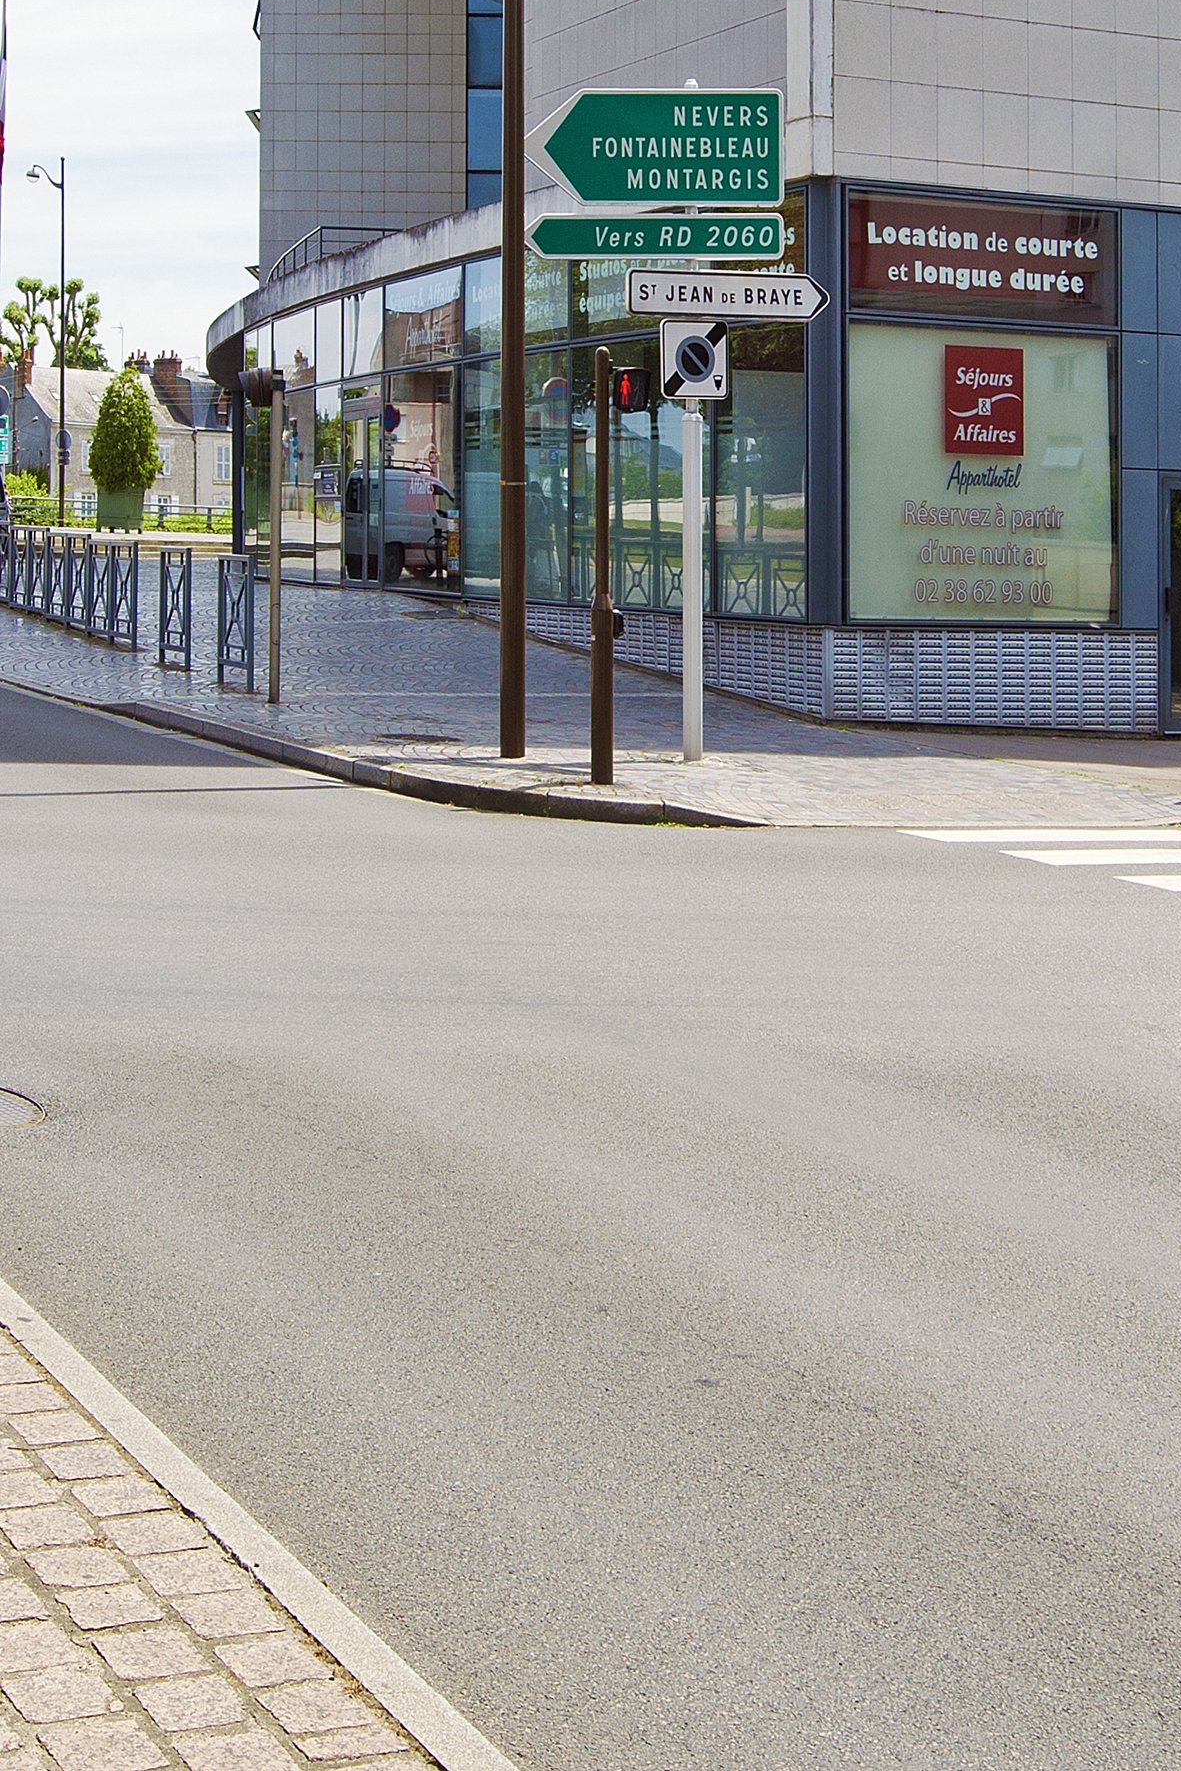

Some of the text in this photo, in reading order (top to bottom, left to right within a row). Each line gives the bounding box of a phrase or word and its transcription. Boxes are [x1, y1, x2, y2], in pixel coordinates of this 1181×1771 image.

[673, 105, 769, 127] NEVERS
[592, 136, 770, 158] FONTAINEBLEAU
[627, 168, 770, 190] MONTARGIS
[594, 226, 645, 247] Vers
[659, 226, 692, 247] RD
[706, 225, 775, 248] 2060
[867, 221, 1098, 260] Location de courte
[579, 259, 627, 282] Studios
[887, 260, 1085, 294] et longue durée
[638, 284, 804, 306] ST JEAN DE BRAYE
[955, 366, 1014, 388] Séjours
[980, 400, 991, 414] &
[953, 423, 1017, 444] Affaires
[409, 477, 434, 495] Affaires
[945, 460, 1022, 495] Apparthotel
[903, 500, 1064, 533] Réservez à partir
[920, 538, 1048, 566] d'une nuit au
[914, 578, 1054, 604] 02 38 62 93 00
